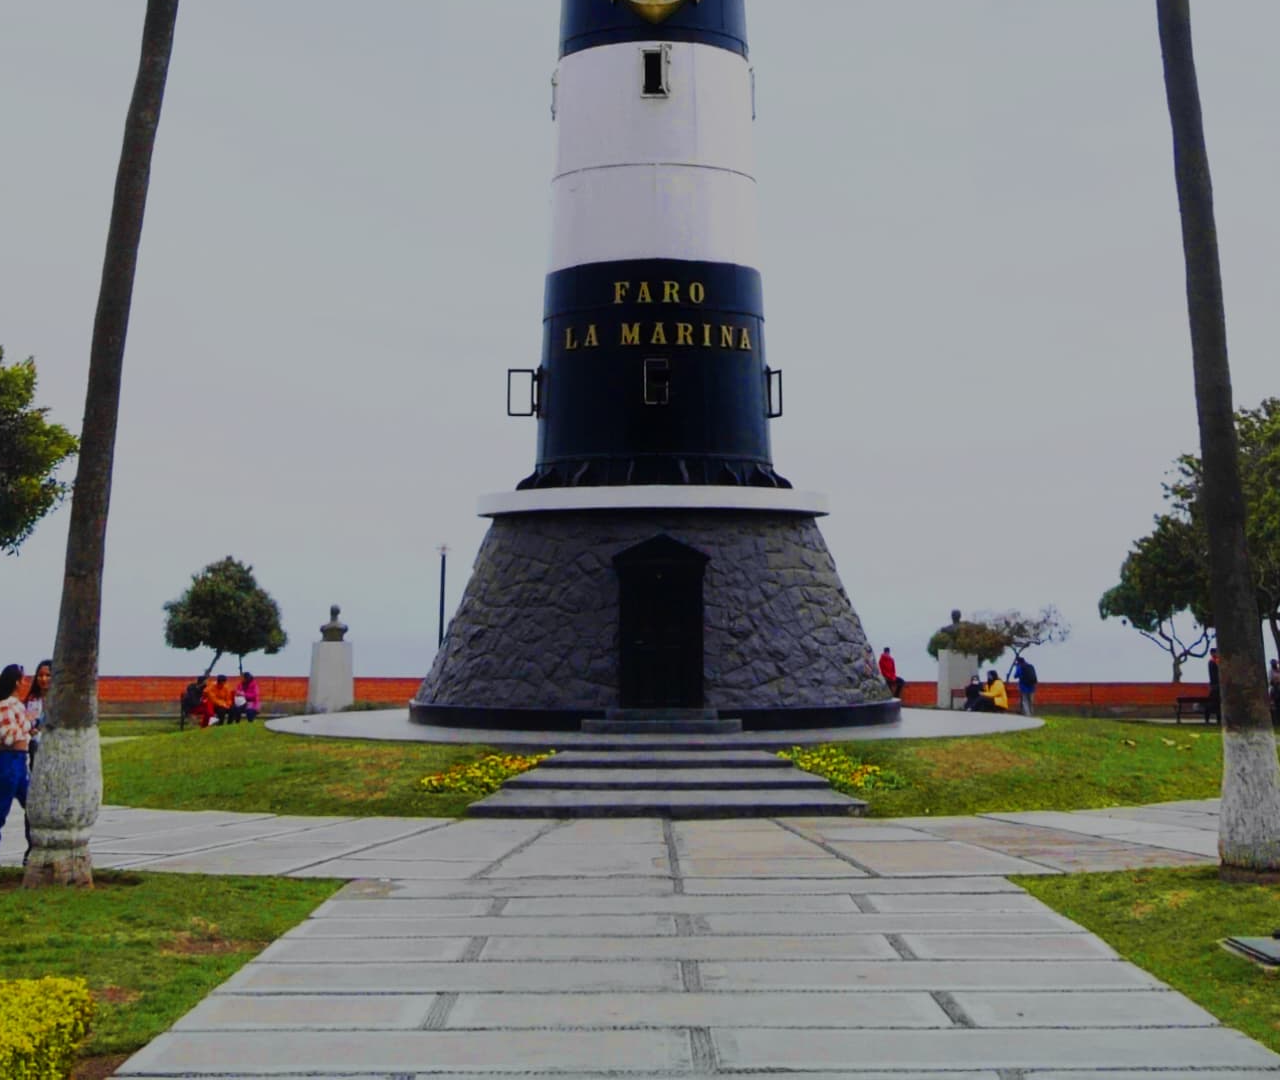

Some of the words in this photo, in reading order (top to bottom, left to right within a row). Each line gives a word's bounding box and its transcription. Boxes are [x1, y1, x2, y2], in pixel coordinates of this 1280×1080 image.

[613, 280, 706, 304] FARO
[564, 324, 598, 350] LA
[620, 322, 752, 350] MARINA
